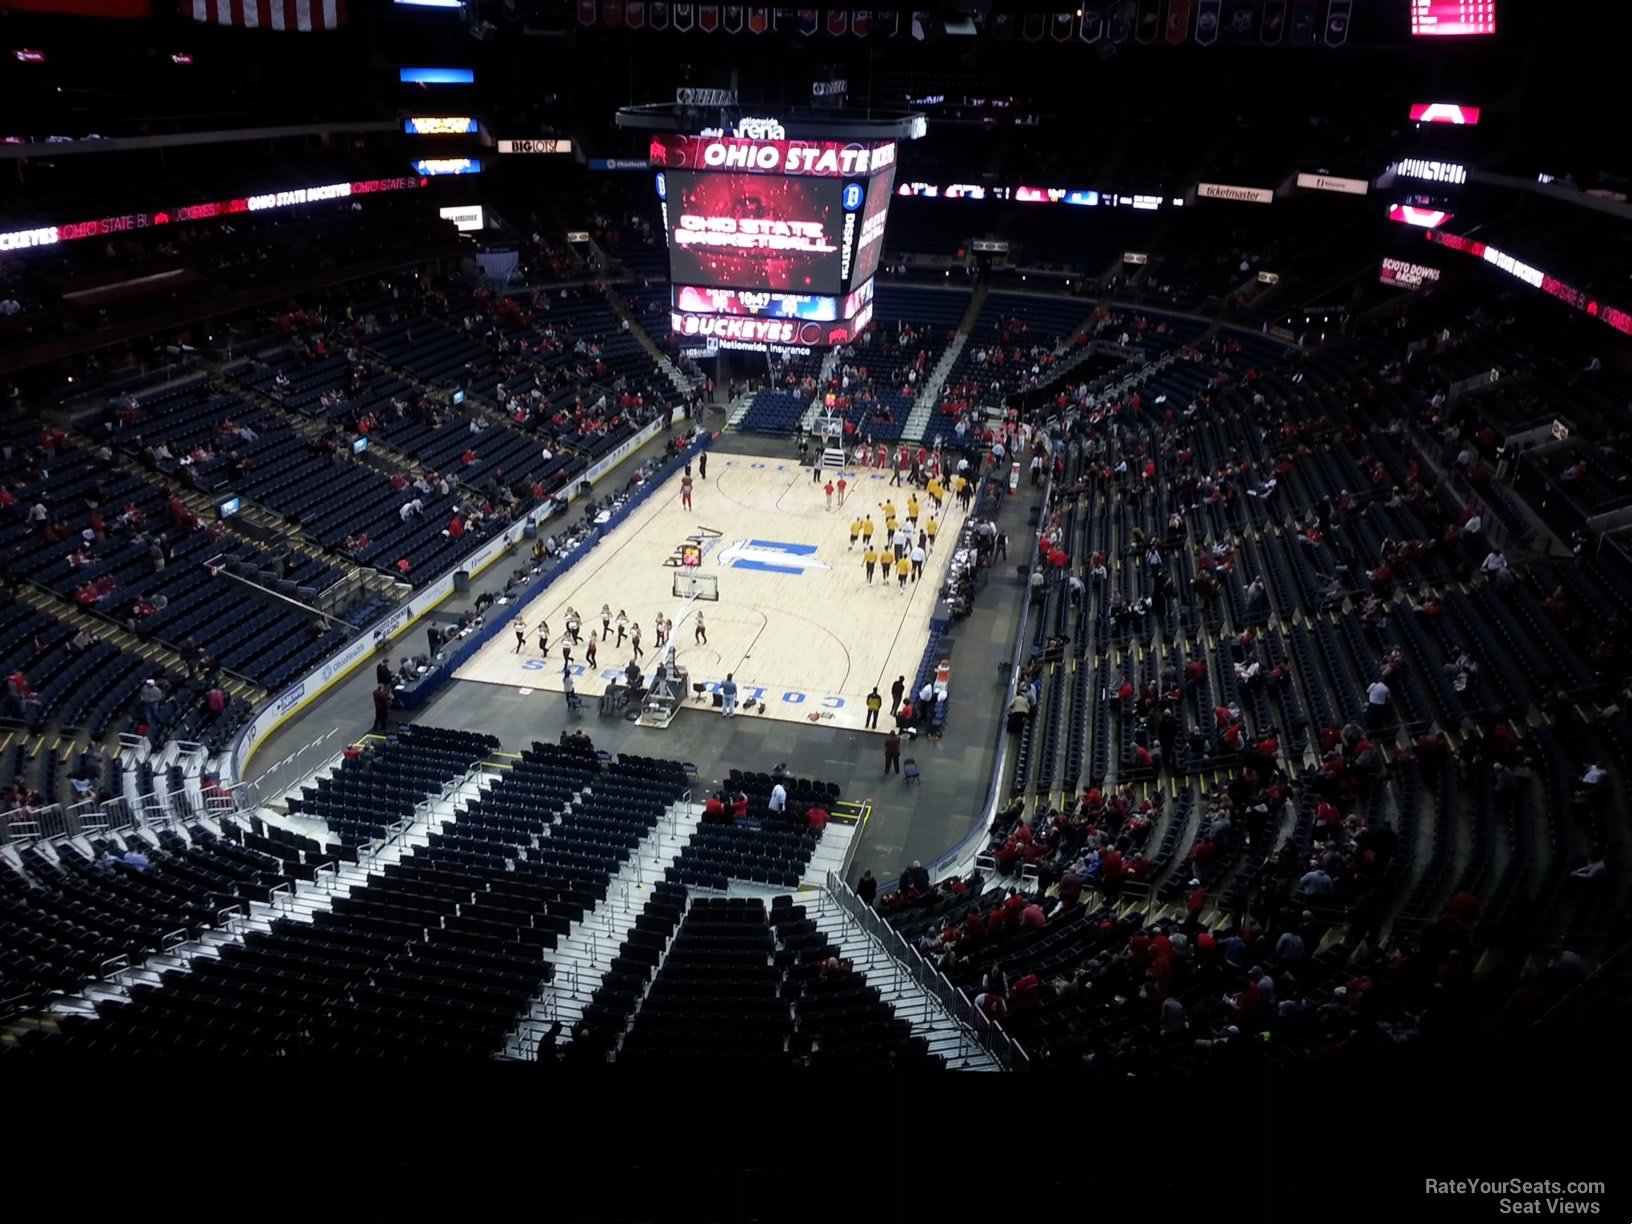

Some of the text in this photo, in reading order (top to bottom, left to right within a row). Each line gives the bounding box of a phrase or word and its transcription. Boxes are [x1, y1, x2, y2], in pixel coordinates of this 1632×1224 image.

[511, 140, 533, 152] BIG
[704, 143, 780, 169] OHIO
[784, 147, 871, 172] STATE
[1206, 186, 1260, 201] ticketmaster
[101, 213, 134, 233] STATE
[680, 214, 737, 232] OHIO
[739, 218, 824, 237] STATE
[841, 213, 856, 280] DISPATCH
[1382, 257, 1440, 281] SCIOTO DOWNS
[685, 315, 794, 342] BUCKEYES
[719, 338, 811, 357] Nationwide Insurance
